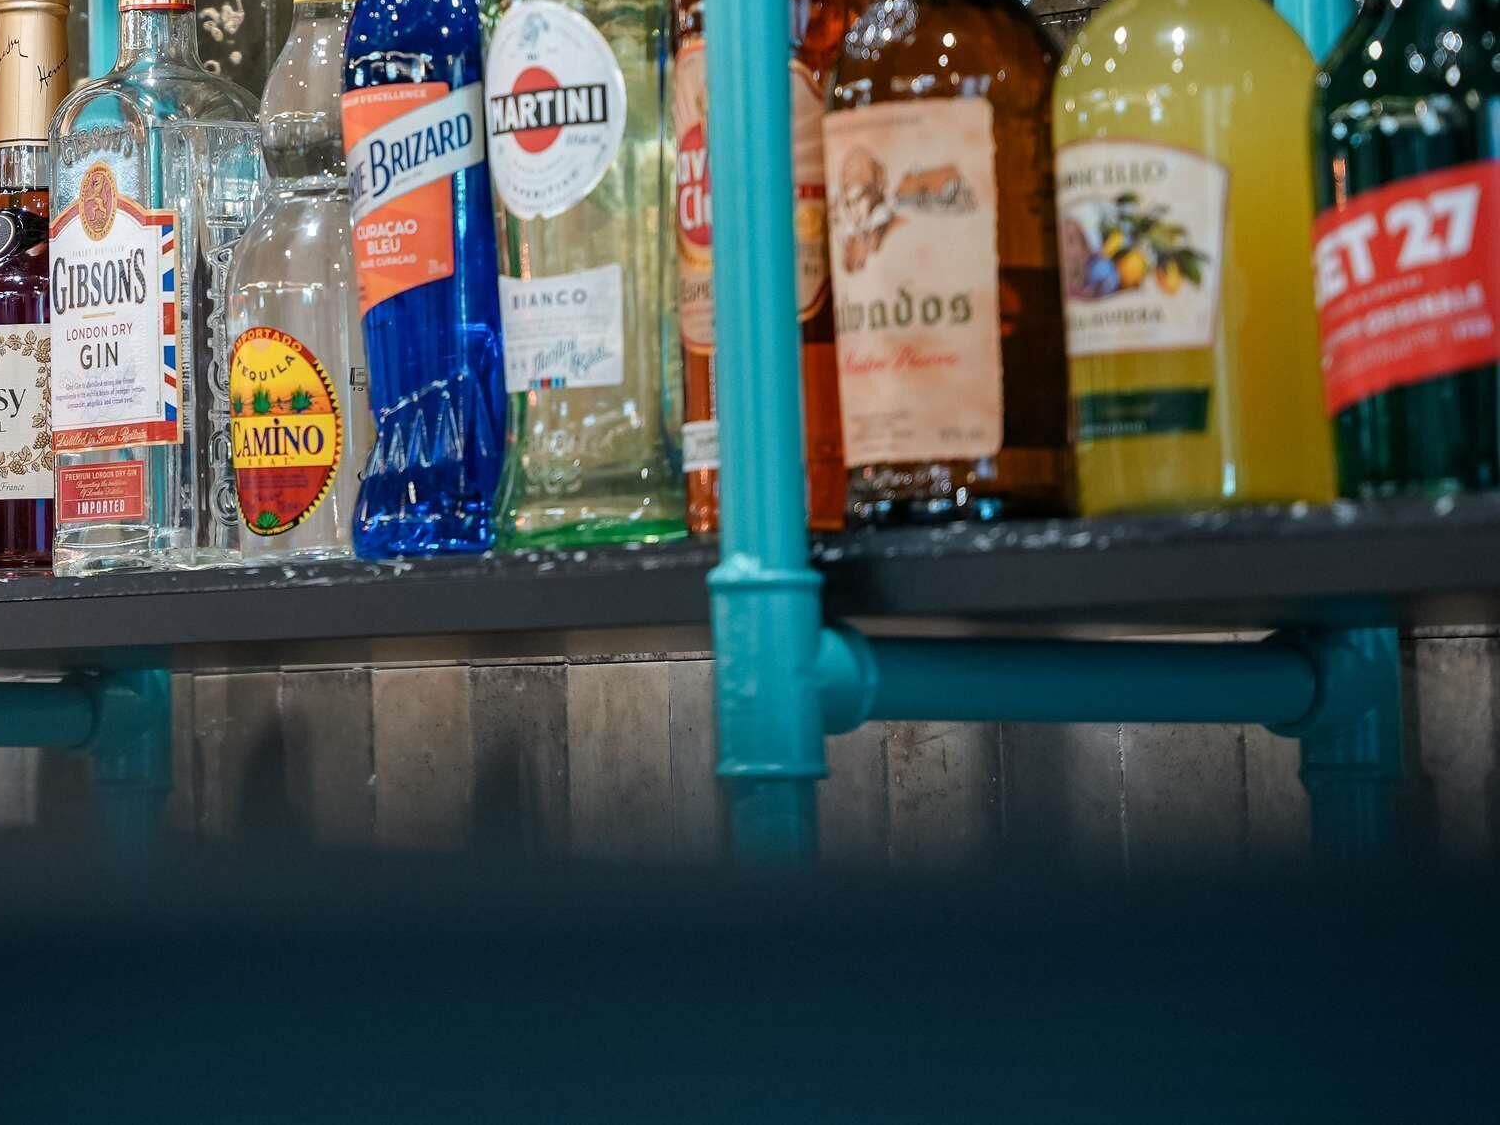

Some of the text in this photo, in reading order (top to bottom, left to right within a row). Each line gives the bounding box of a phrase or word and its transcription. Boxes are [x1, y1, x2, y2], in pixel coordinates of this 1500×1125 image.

[491, 87, 605, 131] MARTINI
[1385, 183, 1481, 271] 27
[367, 238, 401, 256] BLEU
[52, 247, 147, 315] GIBSON'S
[513, 288, 588, 310] BIANCO
[66, 322, 134, 342] LONDON DRY
[80, 341, 118, 370] GIN
[236, 354, 296, 381] TEQUILA
[77, 499, 125, 515] IMPORTED
